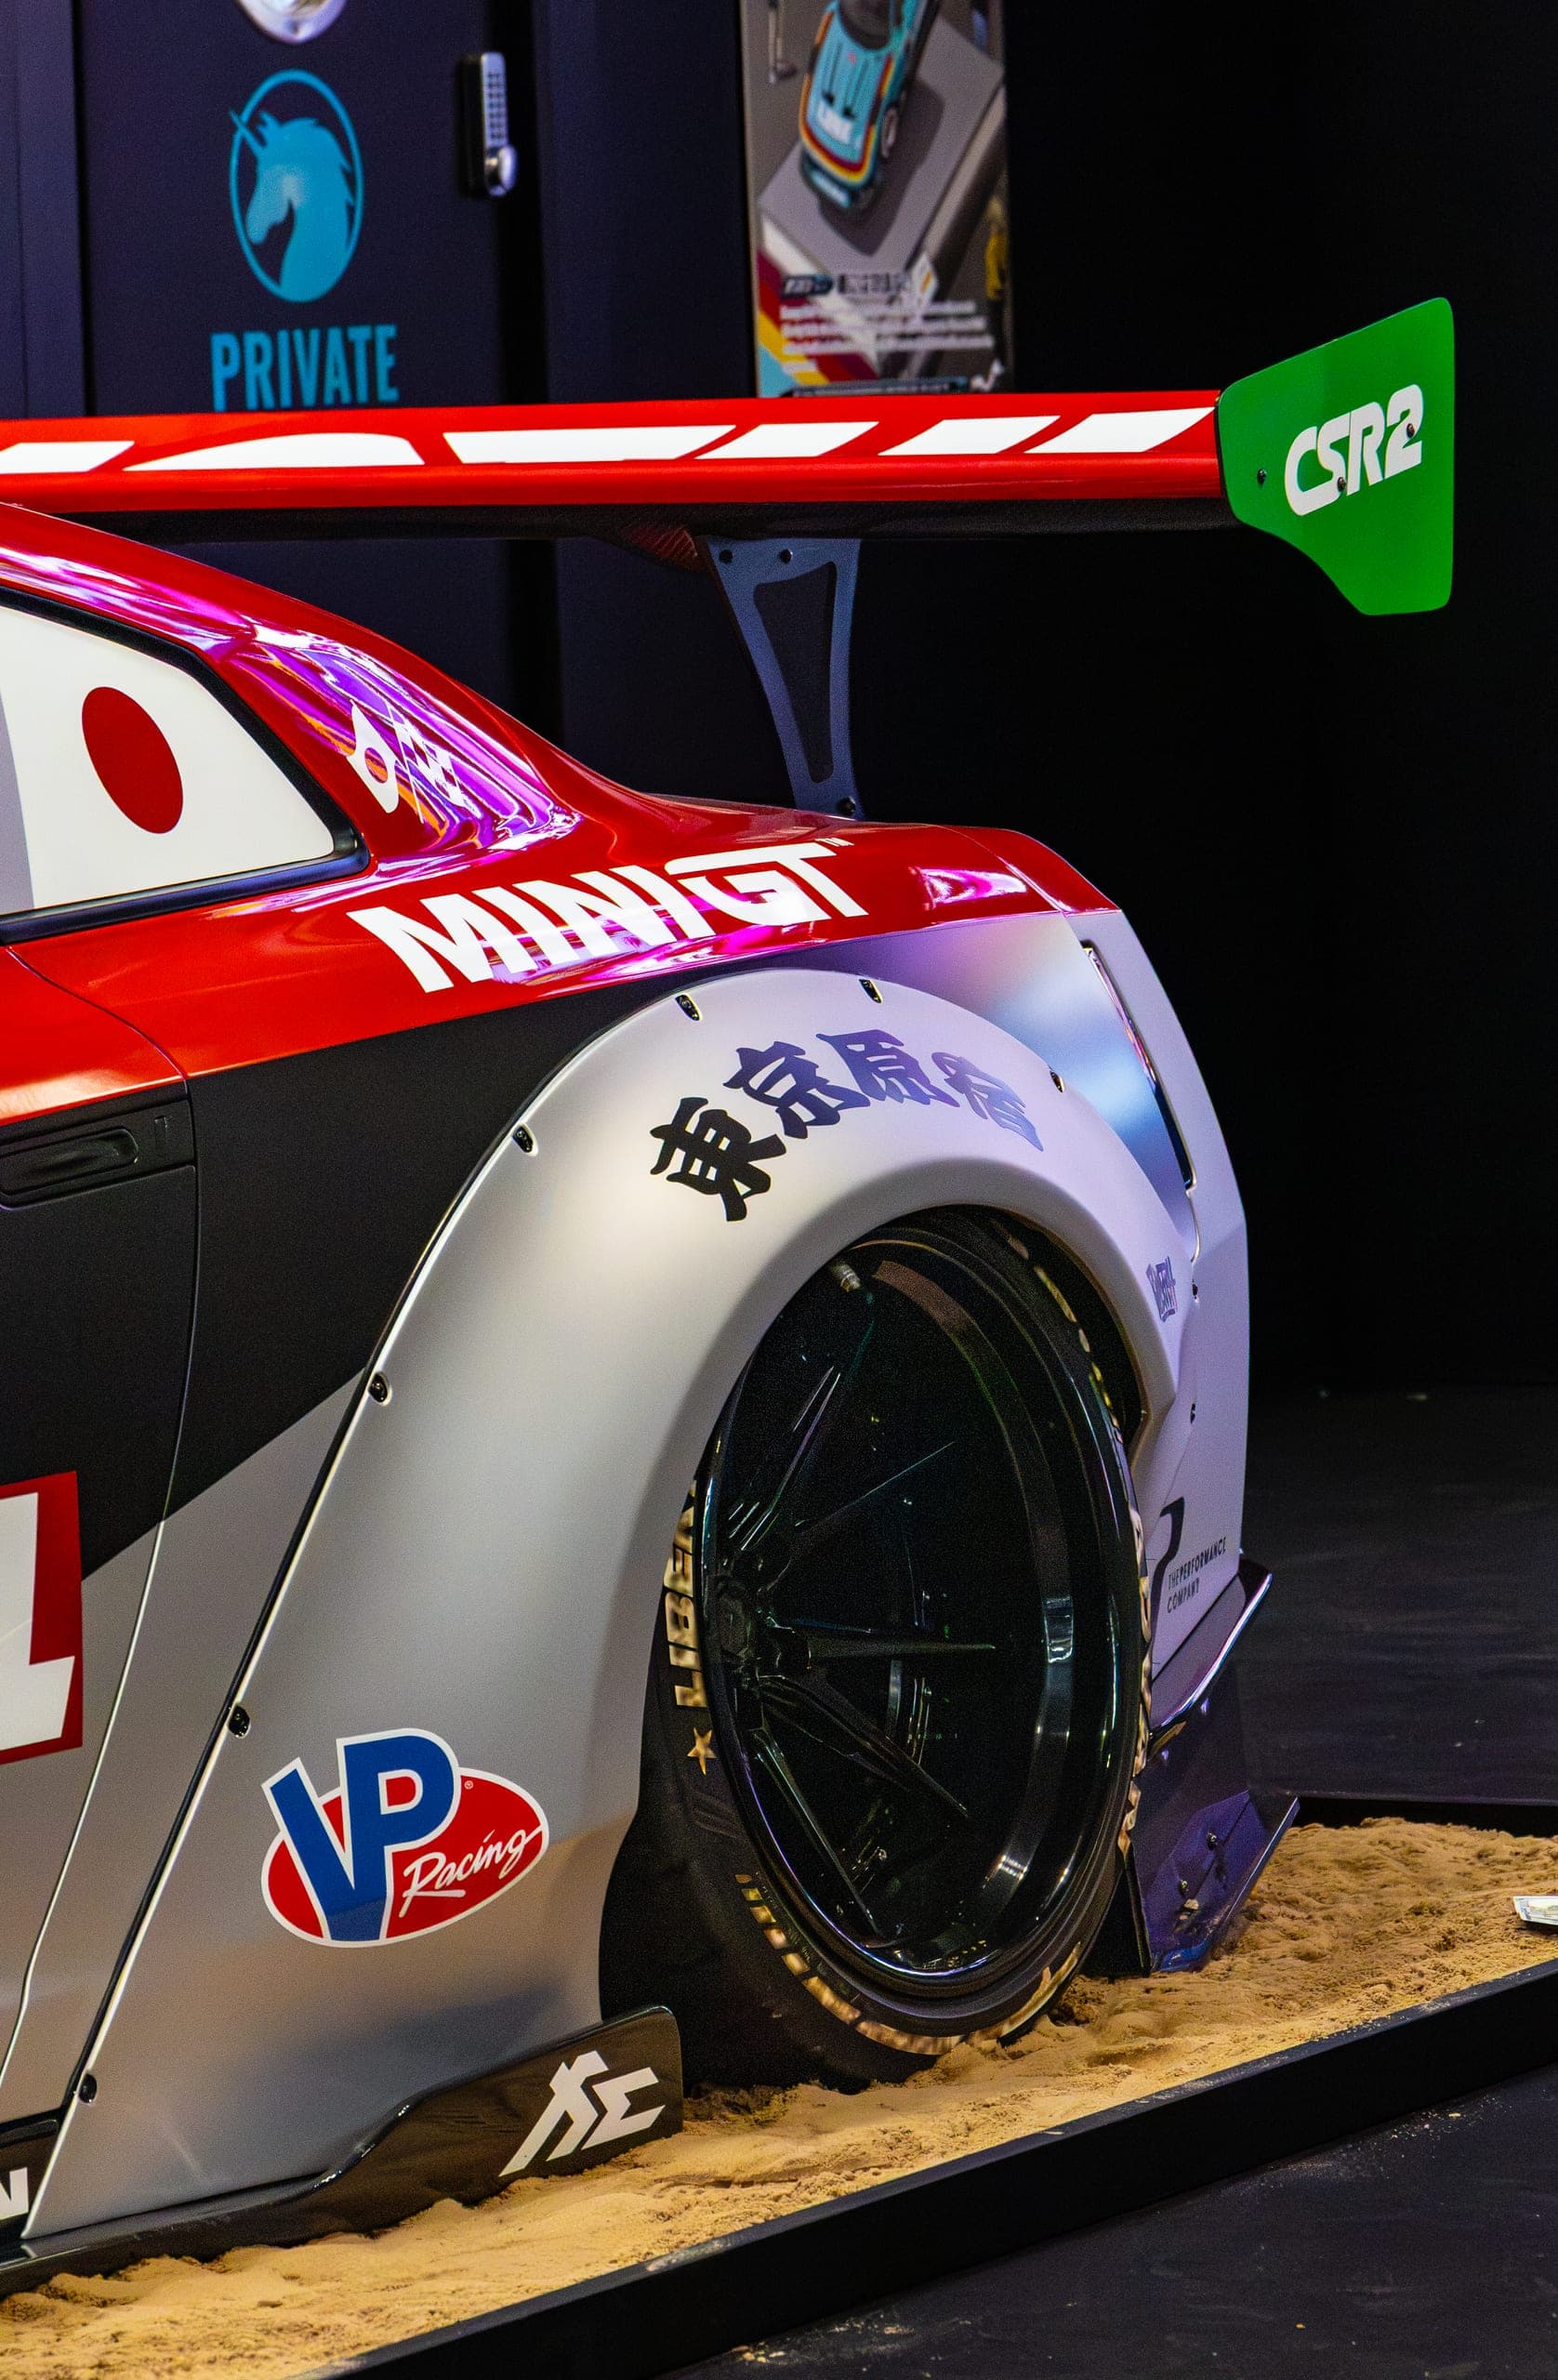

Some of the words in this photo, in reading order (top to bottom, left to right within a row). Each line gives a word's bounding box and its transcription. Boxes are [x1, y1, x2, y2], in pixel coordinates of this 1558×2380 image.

[210, 324, 400, 413] PRIVATE
[1285, 383, 1424, 517] CSR2
[664, 1480, 710, 1708] LIBE
[1167, 1578, 1199, 1614] COMPANY
[262, 1727, 461, 1947] VP
[399, 1829, 539, 1918] Racing
